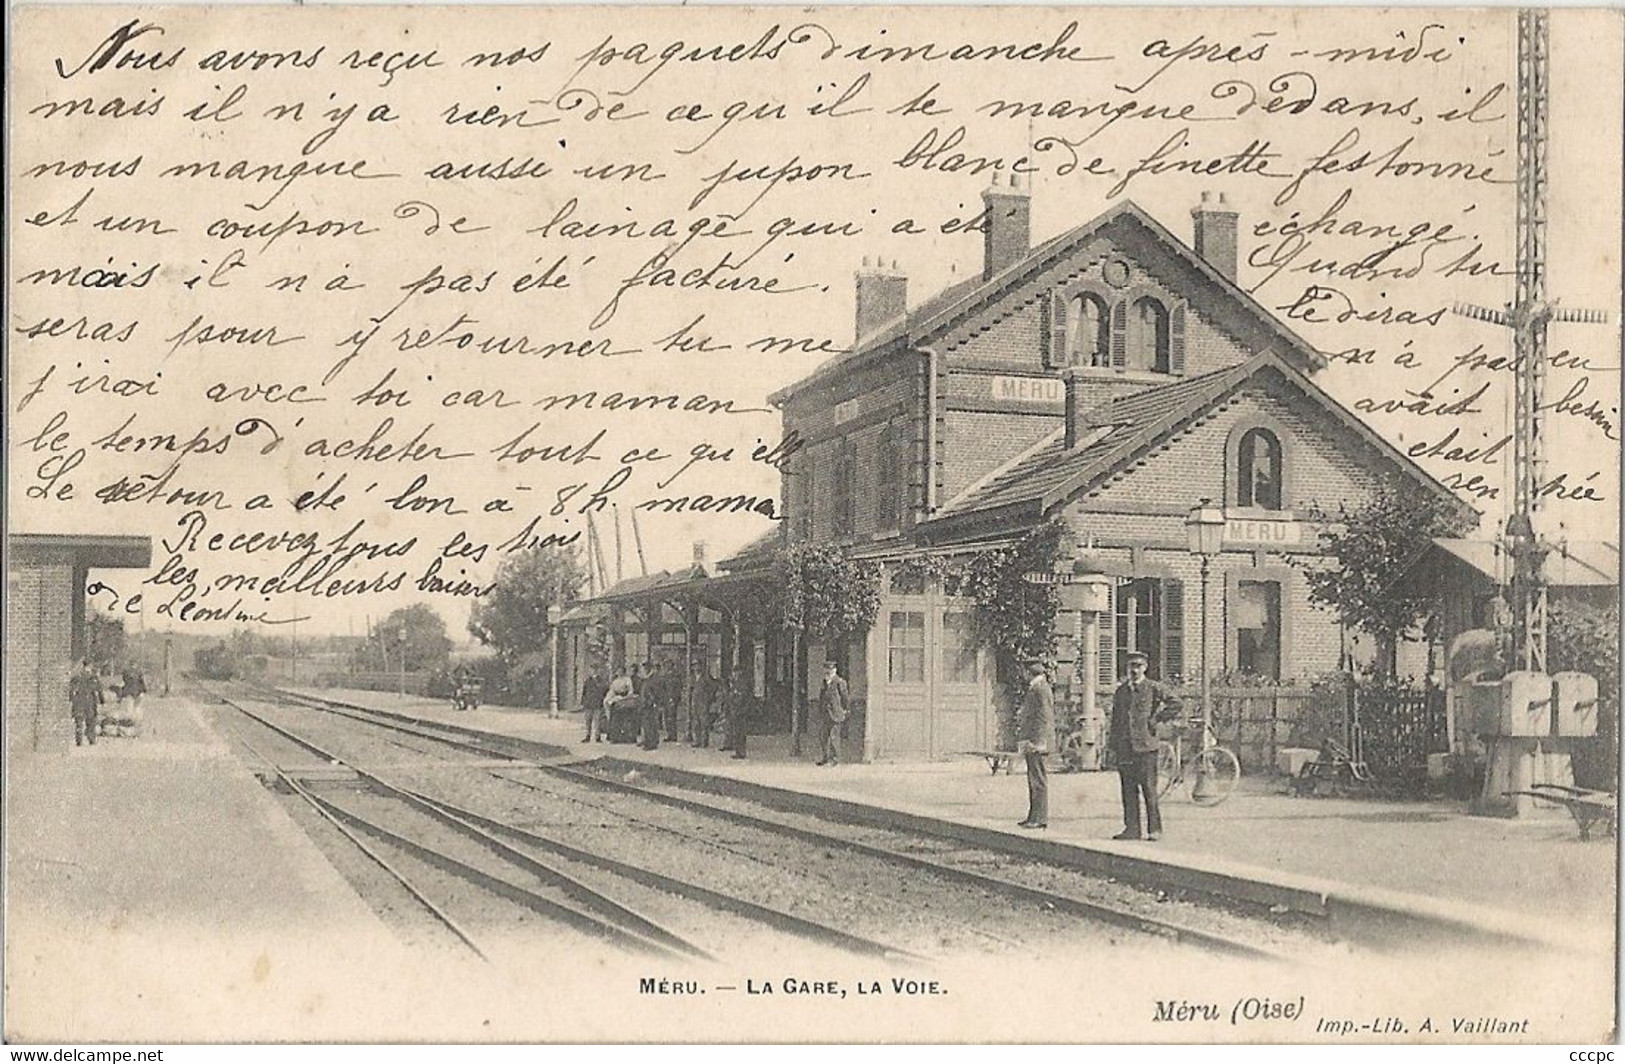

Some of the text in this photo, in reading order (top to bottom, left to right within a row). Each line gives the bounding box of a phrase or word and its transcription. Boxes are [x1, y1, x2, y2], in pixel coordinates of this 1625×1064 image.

[55, 19, 188, 79] Nous
[199, 46, 319, 72] avons
[339, 45, 445, 87] reçu
[461, 41, 552, 68] nos
[554, 25, 783, 96] paquets
[788, 21, 1114, 62] dimanche
[30, 89, 165, 119] mais
[184, 84, 248, 122] il
[440, 85, 561, 128] rien
[556, 89, 650, 121] de
[977, 99, 1237, 146] manque
[1437, 83, 1505, 123] il
[22, 155, 143, 179] nous
[160, 161, 402, 209] manque
[424, 140, 567, 181] aussi
[573, 163, 665, 181] un
[692, 153, 872, 219] jupon
[892, 127, 1039, 177] blanc
[1034, 137, 1114, 176] de
[24, 187, 95, 229] et
[94, 213, 178, 235] un
[206, 208, 380, 254] coupon
[393, 200, 491, 235] de
[891, 219, 926, 235] a
[17, 256, 161, 287] mais
[1434, 243, 1535, 278] tu
[14, 317, 140, 343] seras
[162, 315, 306, 368] pour
[398, 314, 642, 357] retourner
[655, 315, 733, 353] tu
[747, 335, 852, 353] me
[206, 381, 326, 404] avec
[351, 368, 433, 407] toi
[441, 390, 523, 409] car
[531, 392, 772, 413] maman
[17, 411, 68, 453] le
[91, 412, 233, 476] temps
[490, 423, 607, 462] tout
[620, 445, 672, 463] ce
[1354, 381, 1490, 416] avait
[25, 450, 86, 500] Le
[244, 493, 274, 510] a
[162, 510, 322, 578] Recevez
[439, 531, 488, 562] les
[1230, 522, 1286, 541] MERU
